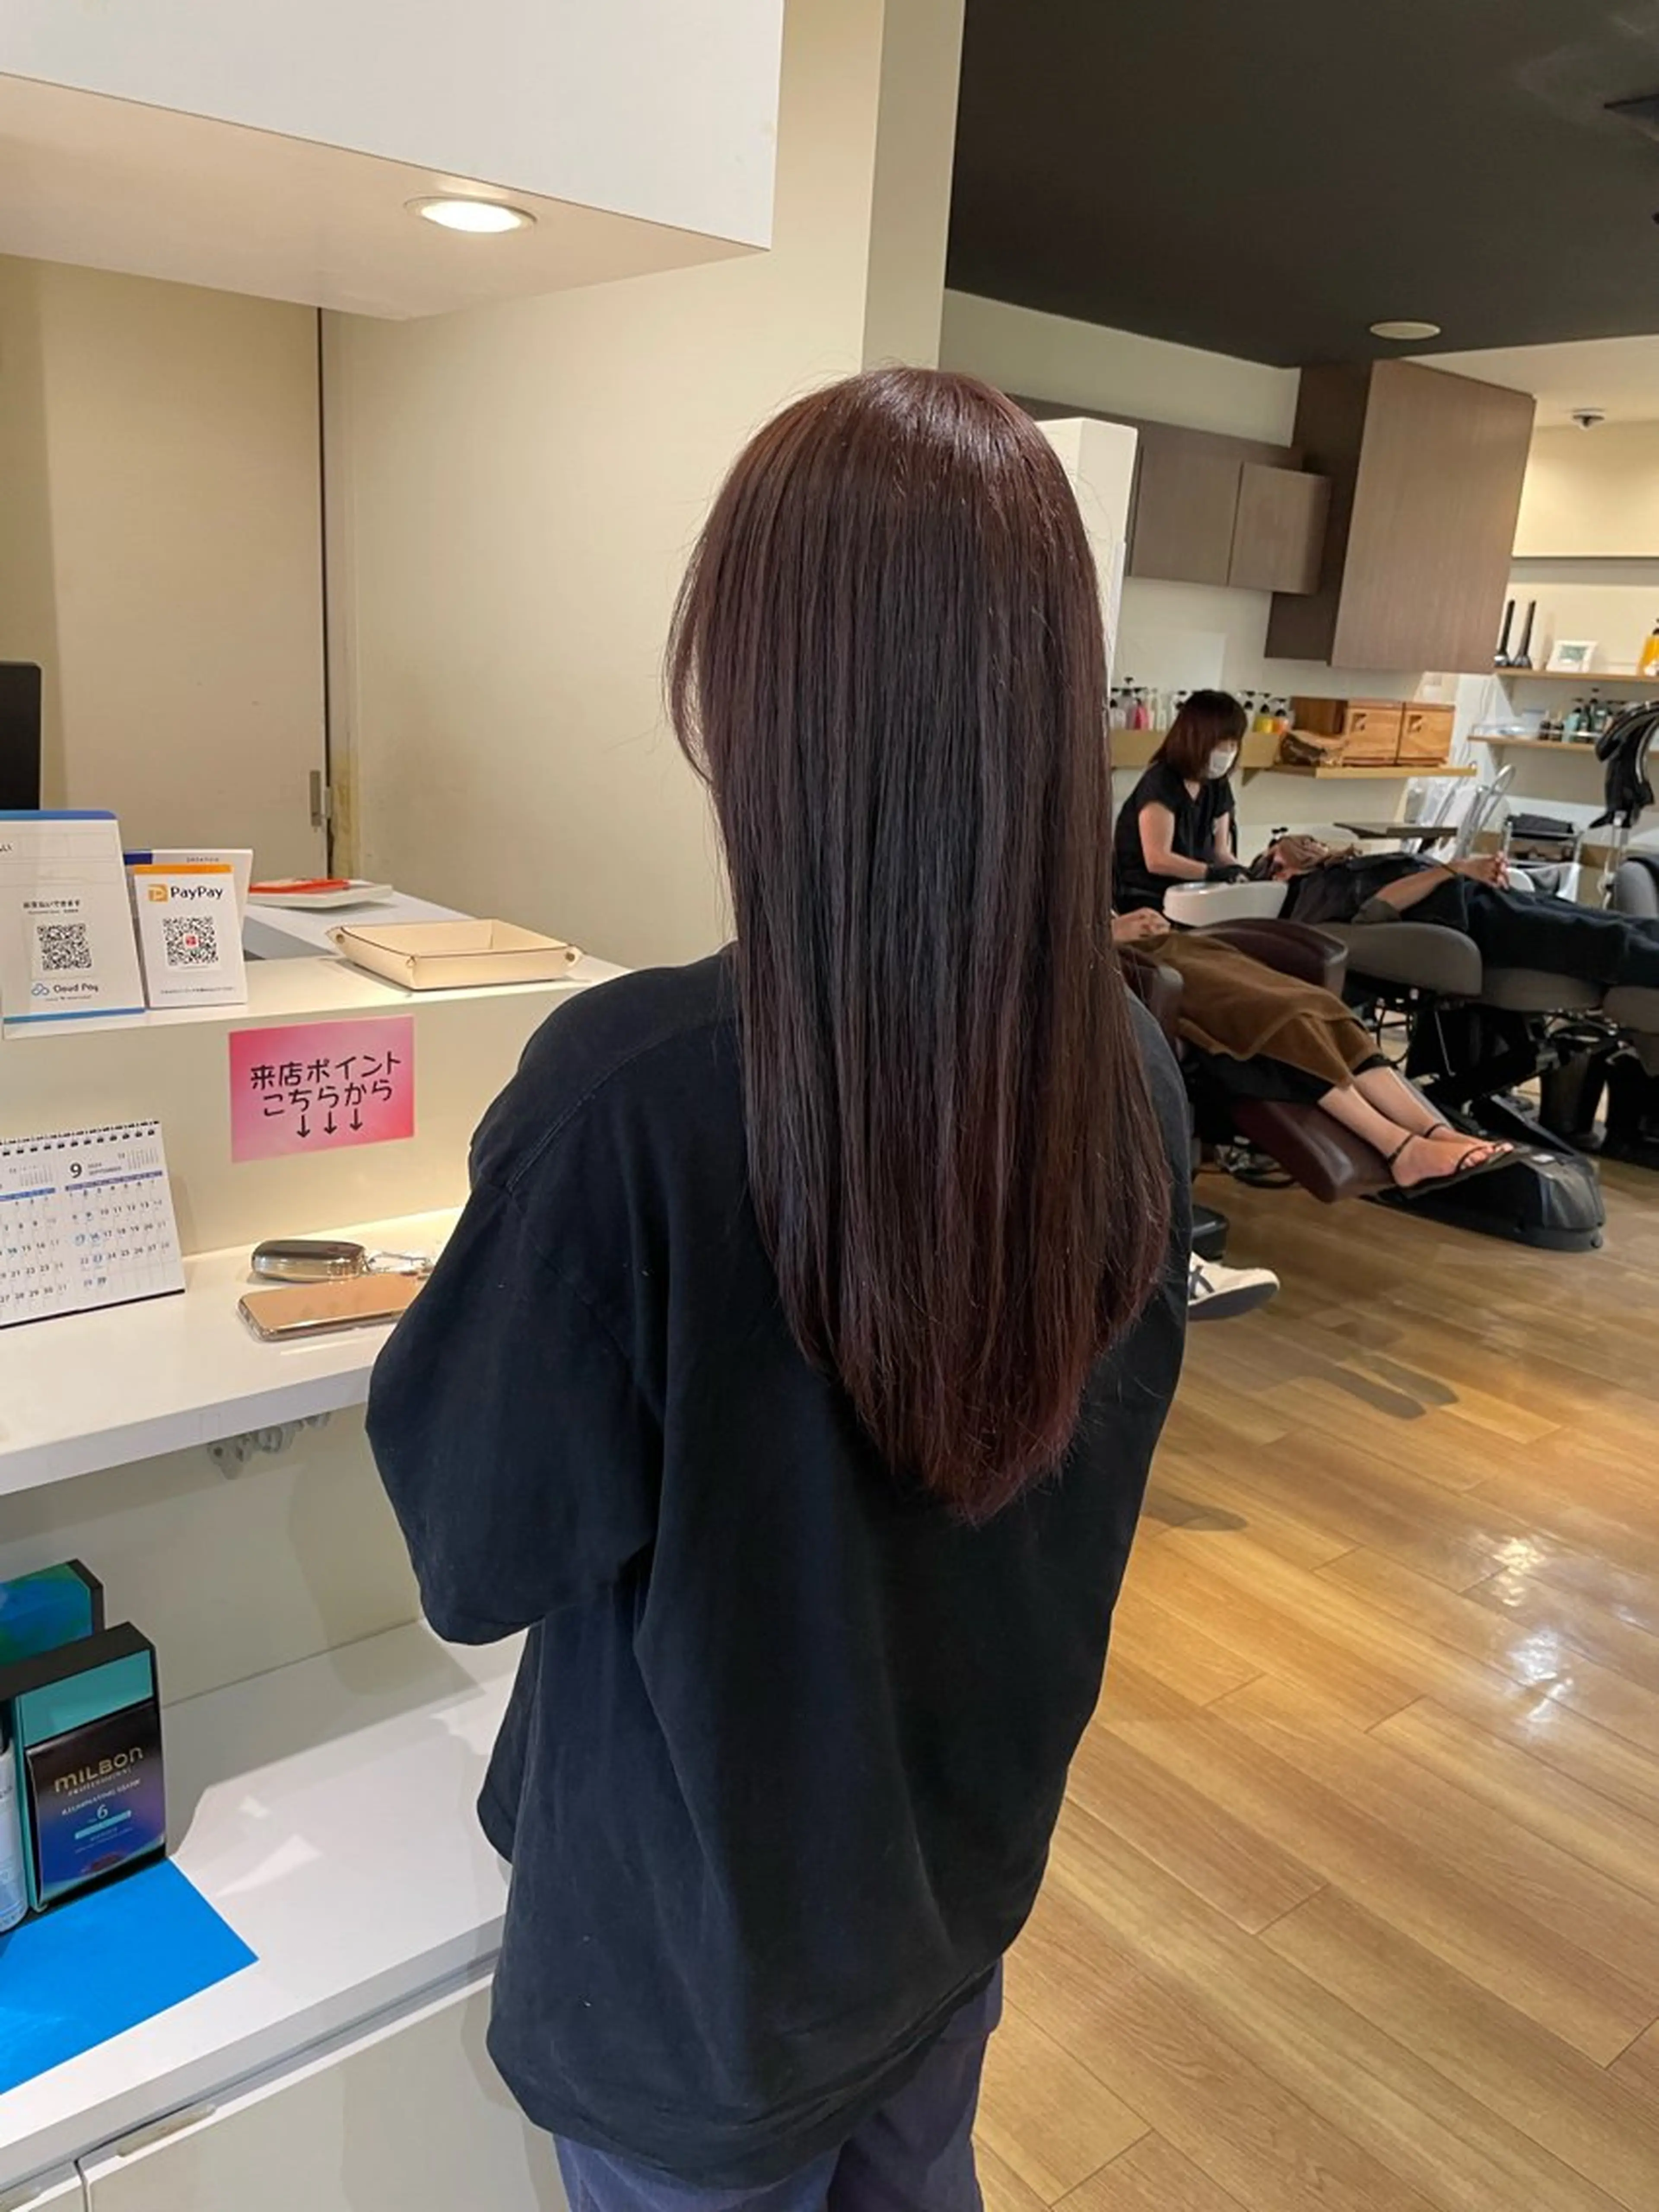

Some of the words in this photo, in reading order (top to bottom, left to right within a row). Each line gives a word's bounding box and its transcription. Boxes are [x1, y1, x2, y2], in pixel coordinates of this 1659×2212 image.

[170, 885, 223, 900] PayPay
[251, 1051, 401, 1090] 来店ポイント
[263, 1078, 393, 1117] こちらから
[70, 1163, 82, 1179] 9
[97, 1804, 108, 1819] 6
